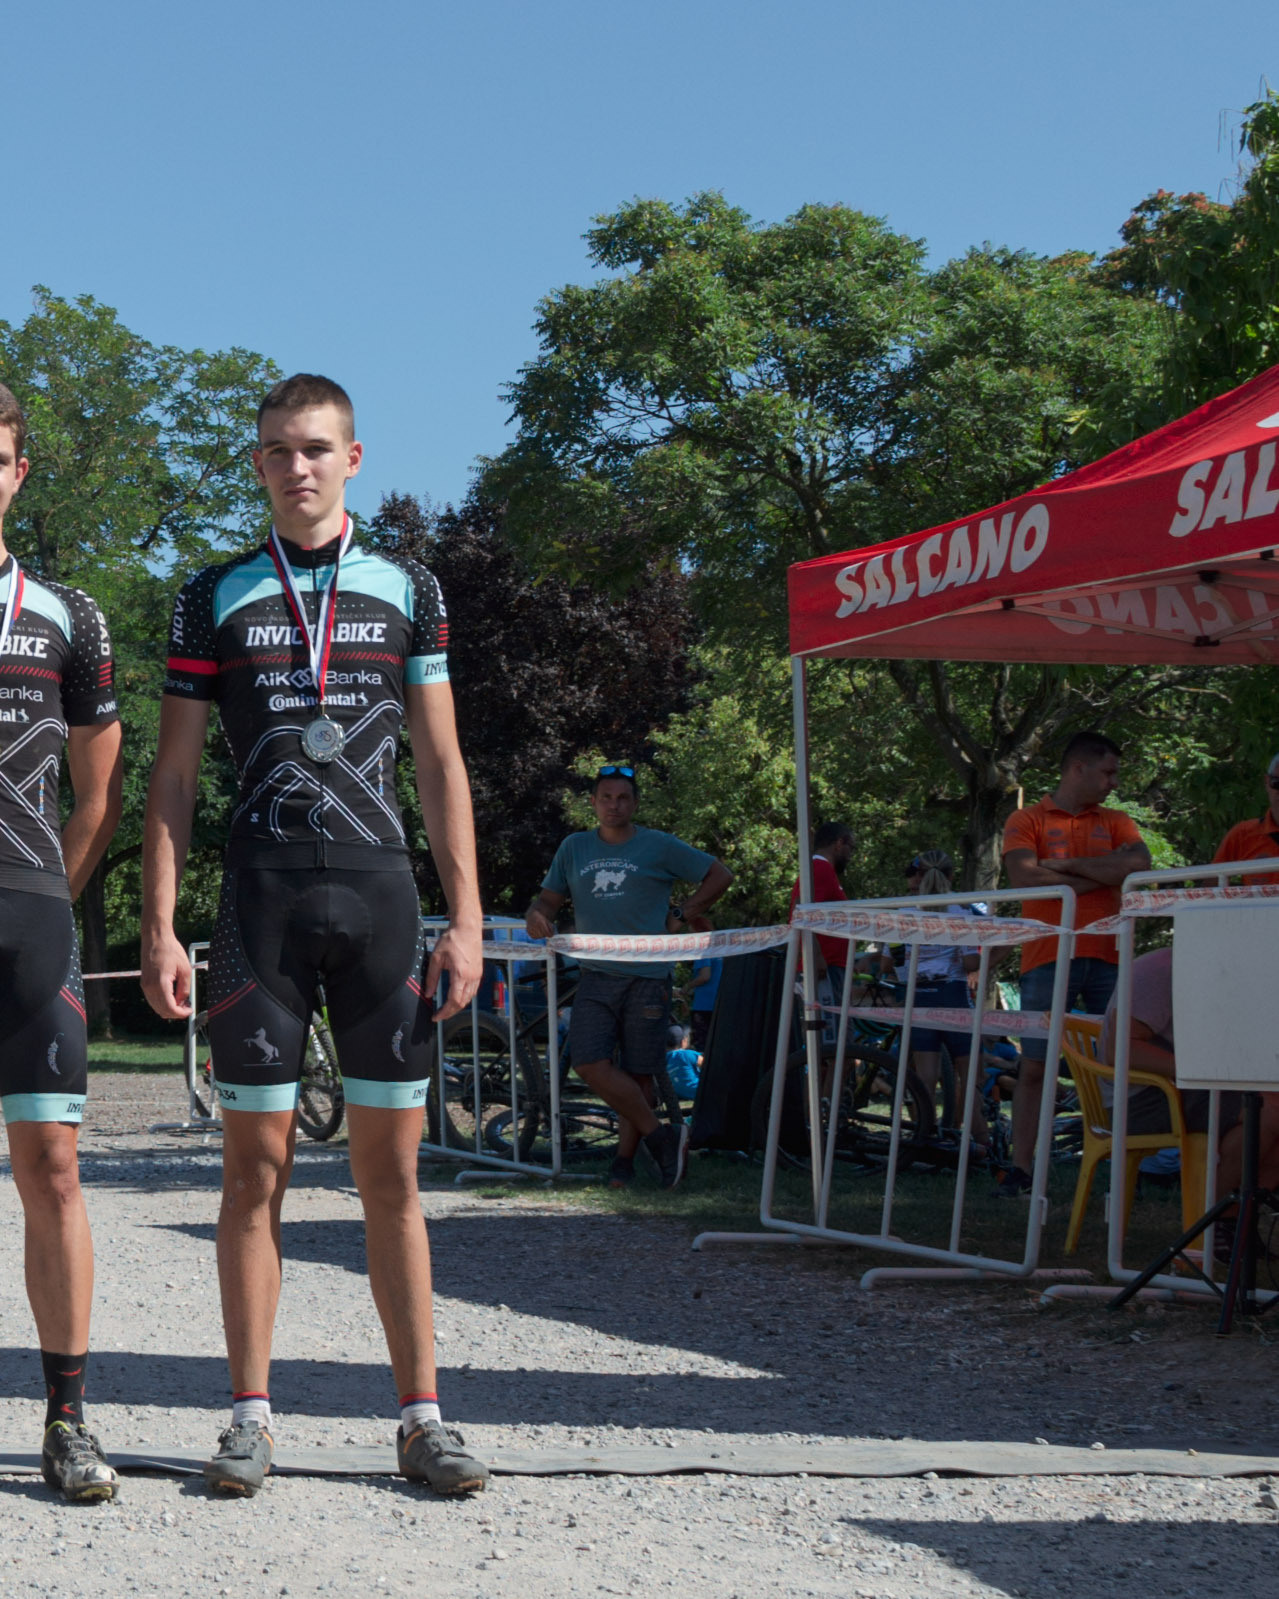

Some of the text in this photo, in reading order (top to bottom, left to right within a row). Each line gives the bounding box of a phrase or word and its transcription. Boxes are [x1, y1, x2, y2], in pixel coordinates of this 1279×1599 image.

[834, 503, 1050, 618] SALCANO
[172, 593, 186, 645] NOVI
[255, 670, 383, 687] AIK Banka
